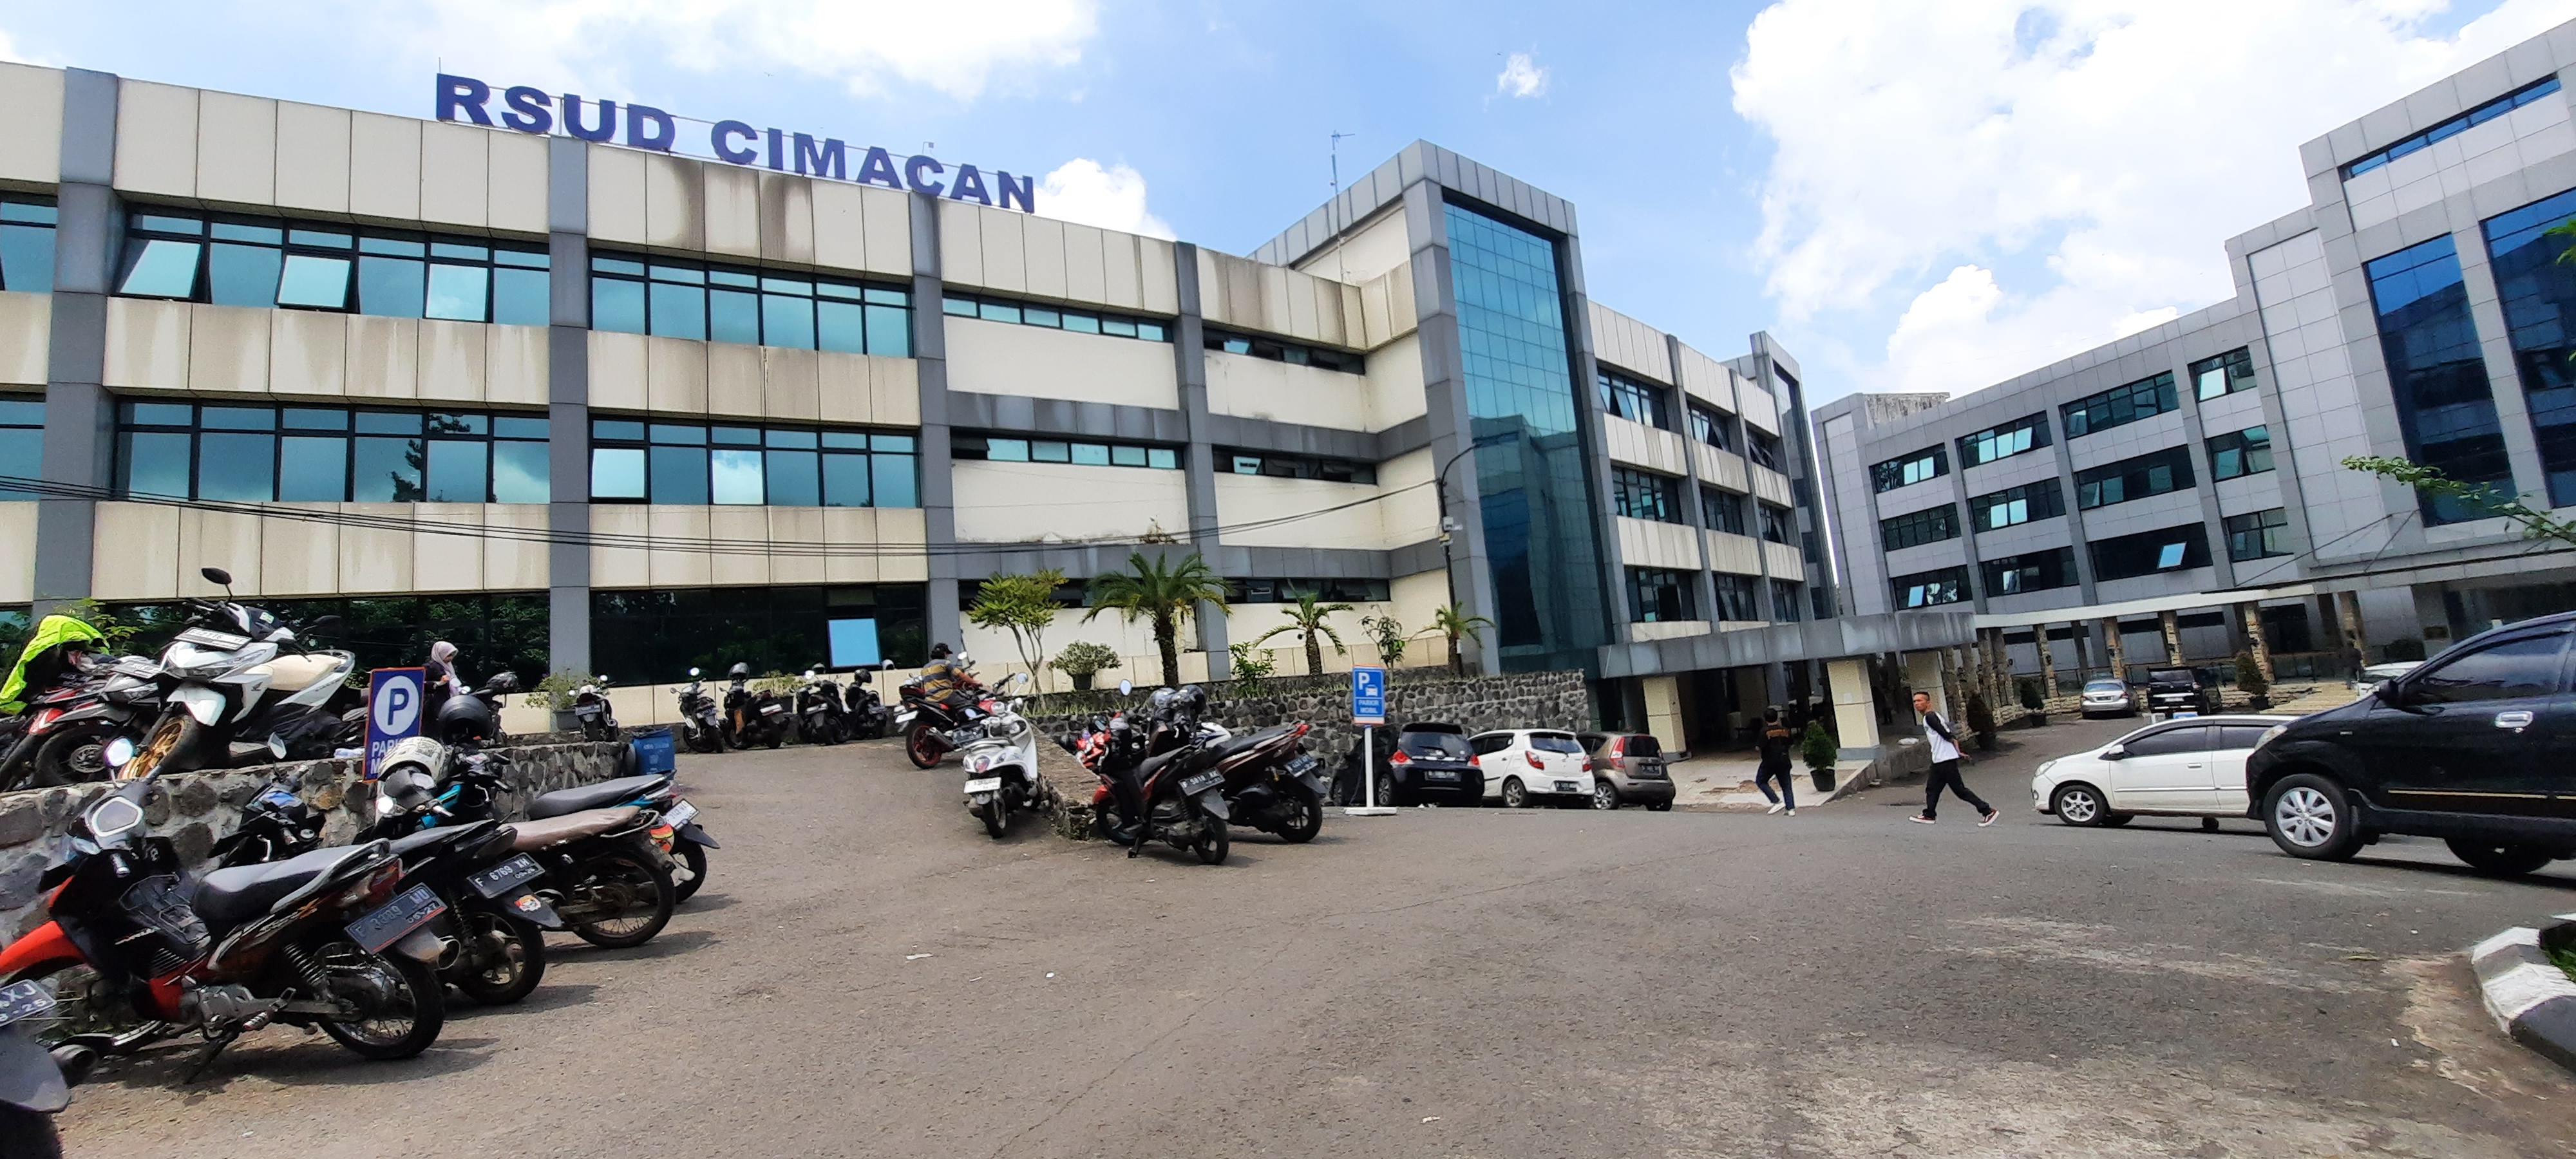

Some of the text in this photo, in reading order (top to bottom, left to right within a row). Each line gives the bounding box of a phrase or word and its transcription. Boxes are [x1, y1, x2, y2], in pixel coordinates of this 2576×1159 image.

[436, 73, 1035, 214] RSUD CIMACAN
[1358, 672, 1370, 690] P
[387, 688, 410, 726] P
[474, 877, 484, 887] F
[489, 865, 513, 881] 6769
[355, 925, 366, 938] F
